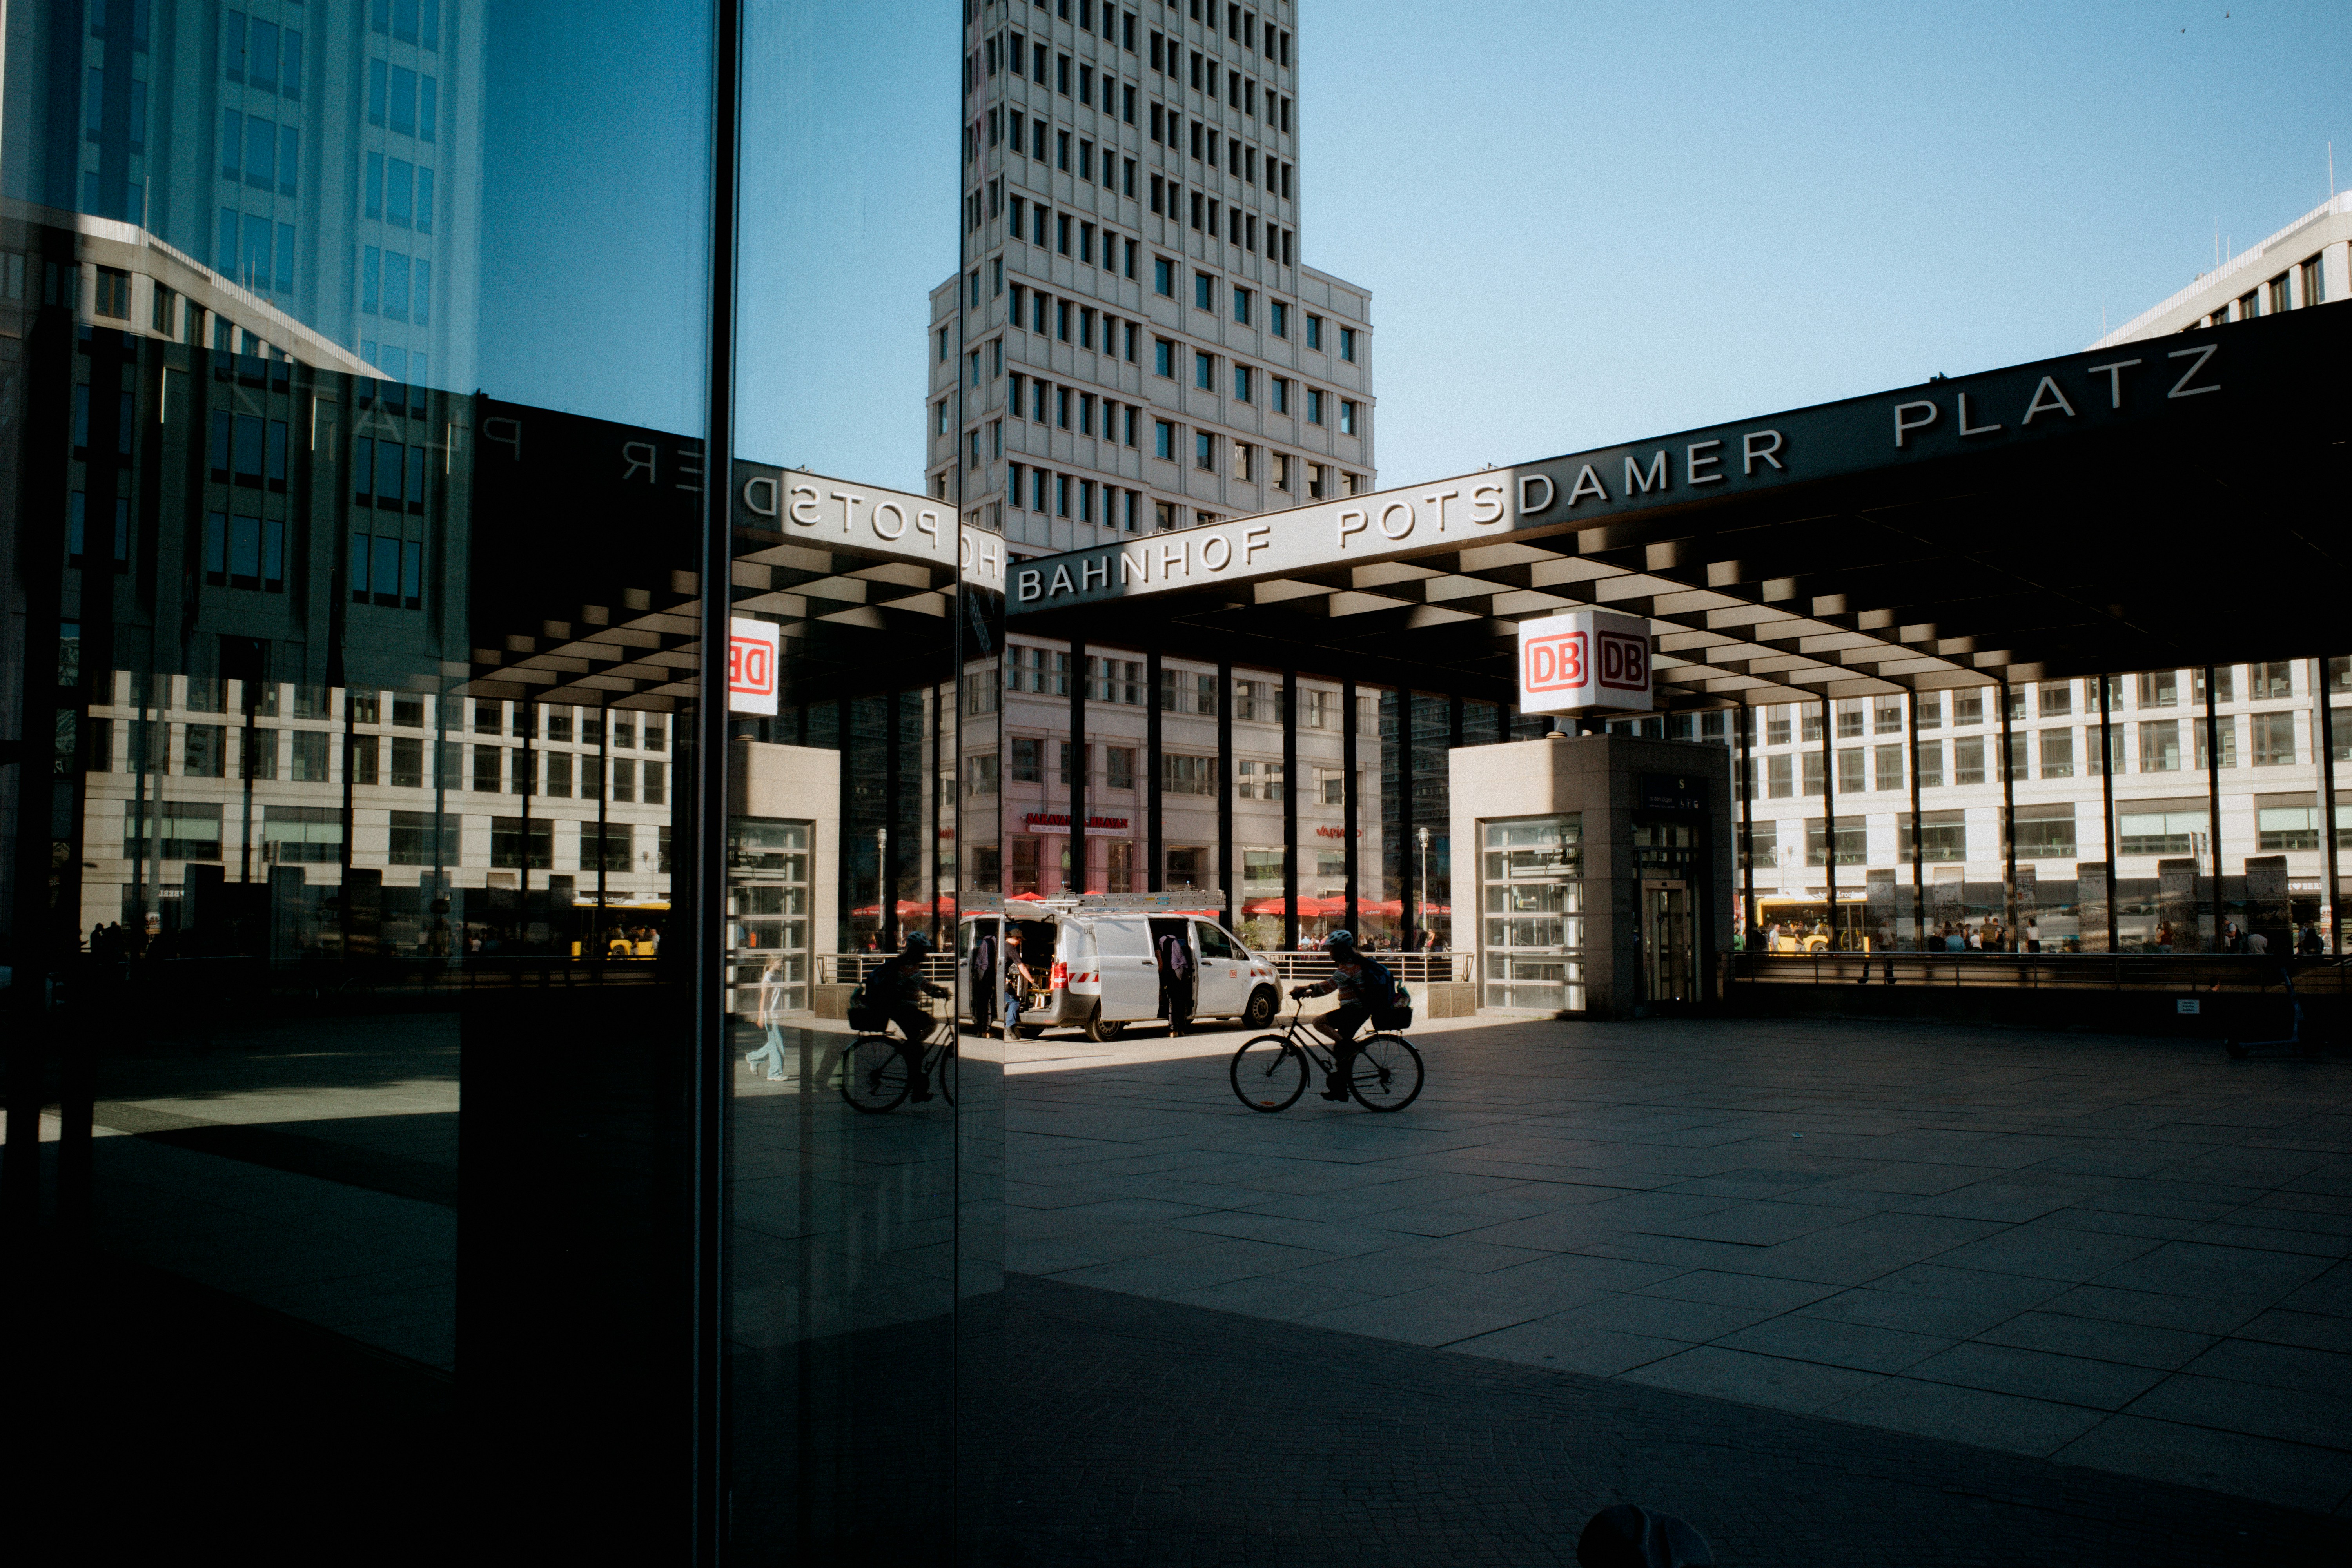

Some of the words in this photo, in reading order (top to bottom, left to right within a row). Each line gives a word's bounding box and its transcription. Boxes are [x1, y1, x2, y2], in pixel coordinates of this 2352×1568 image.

[1018, 526, 1270, 602] BAHNHOF
[1337, 430, 1782, 547] POTSDAMER
[1893, 344, 2221, 447] PLATZ
[1533, 642, 1581, 684] DB
[1604, 640, 1642, 682] DB
[1679, 778, 1685, 789] S
[1090, 817, 1128, 828] BHAVAN
